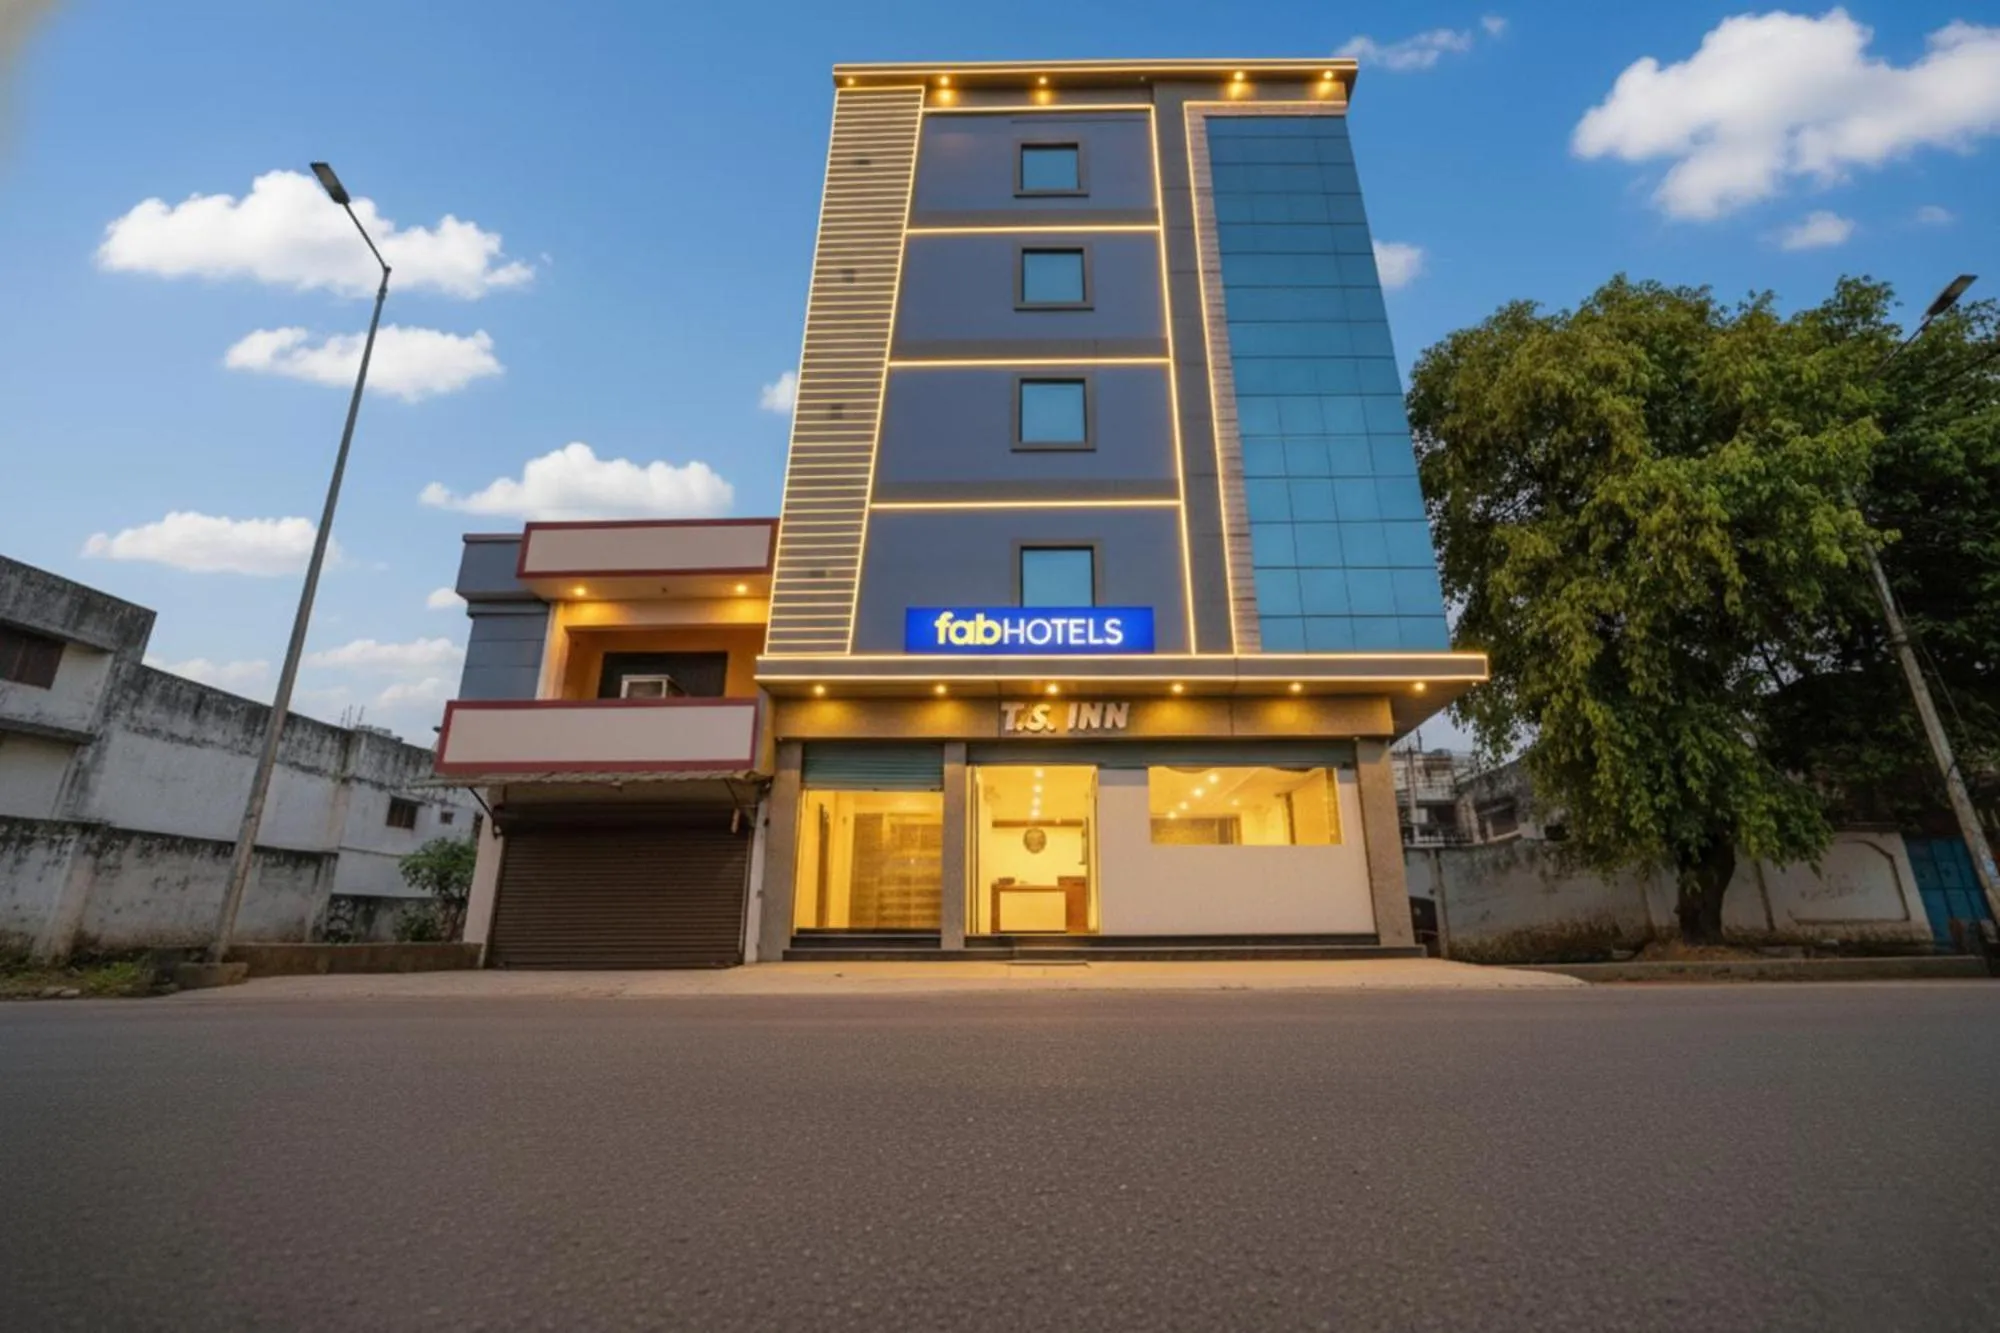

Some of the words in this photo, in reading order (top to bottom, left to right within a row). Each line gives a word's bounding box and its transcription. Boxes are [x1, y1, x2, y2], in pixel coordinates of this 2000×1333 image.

[934, 612, 1124, 645] fabHOTELS
[1001, 703, 1055, 731] T.S.
[1067, 702, 1129, 729] INN
